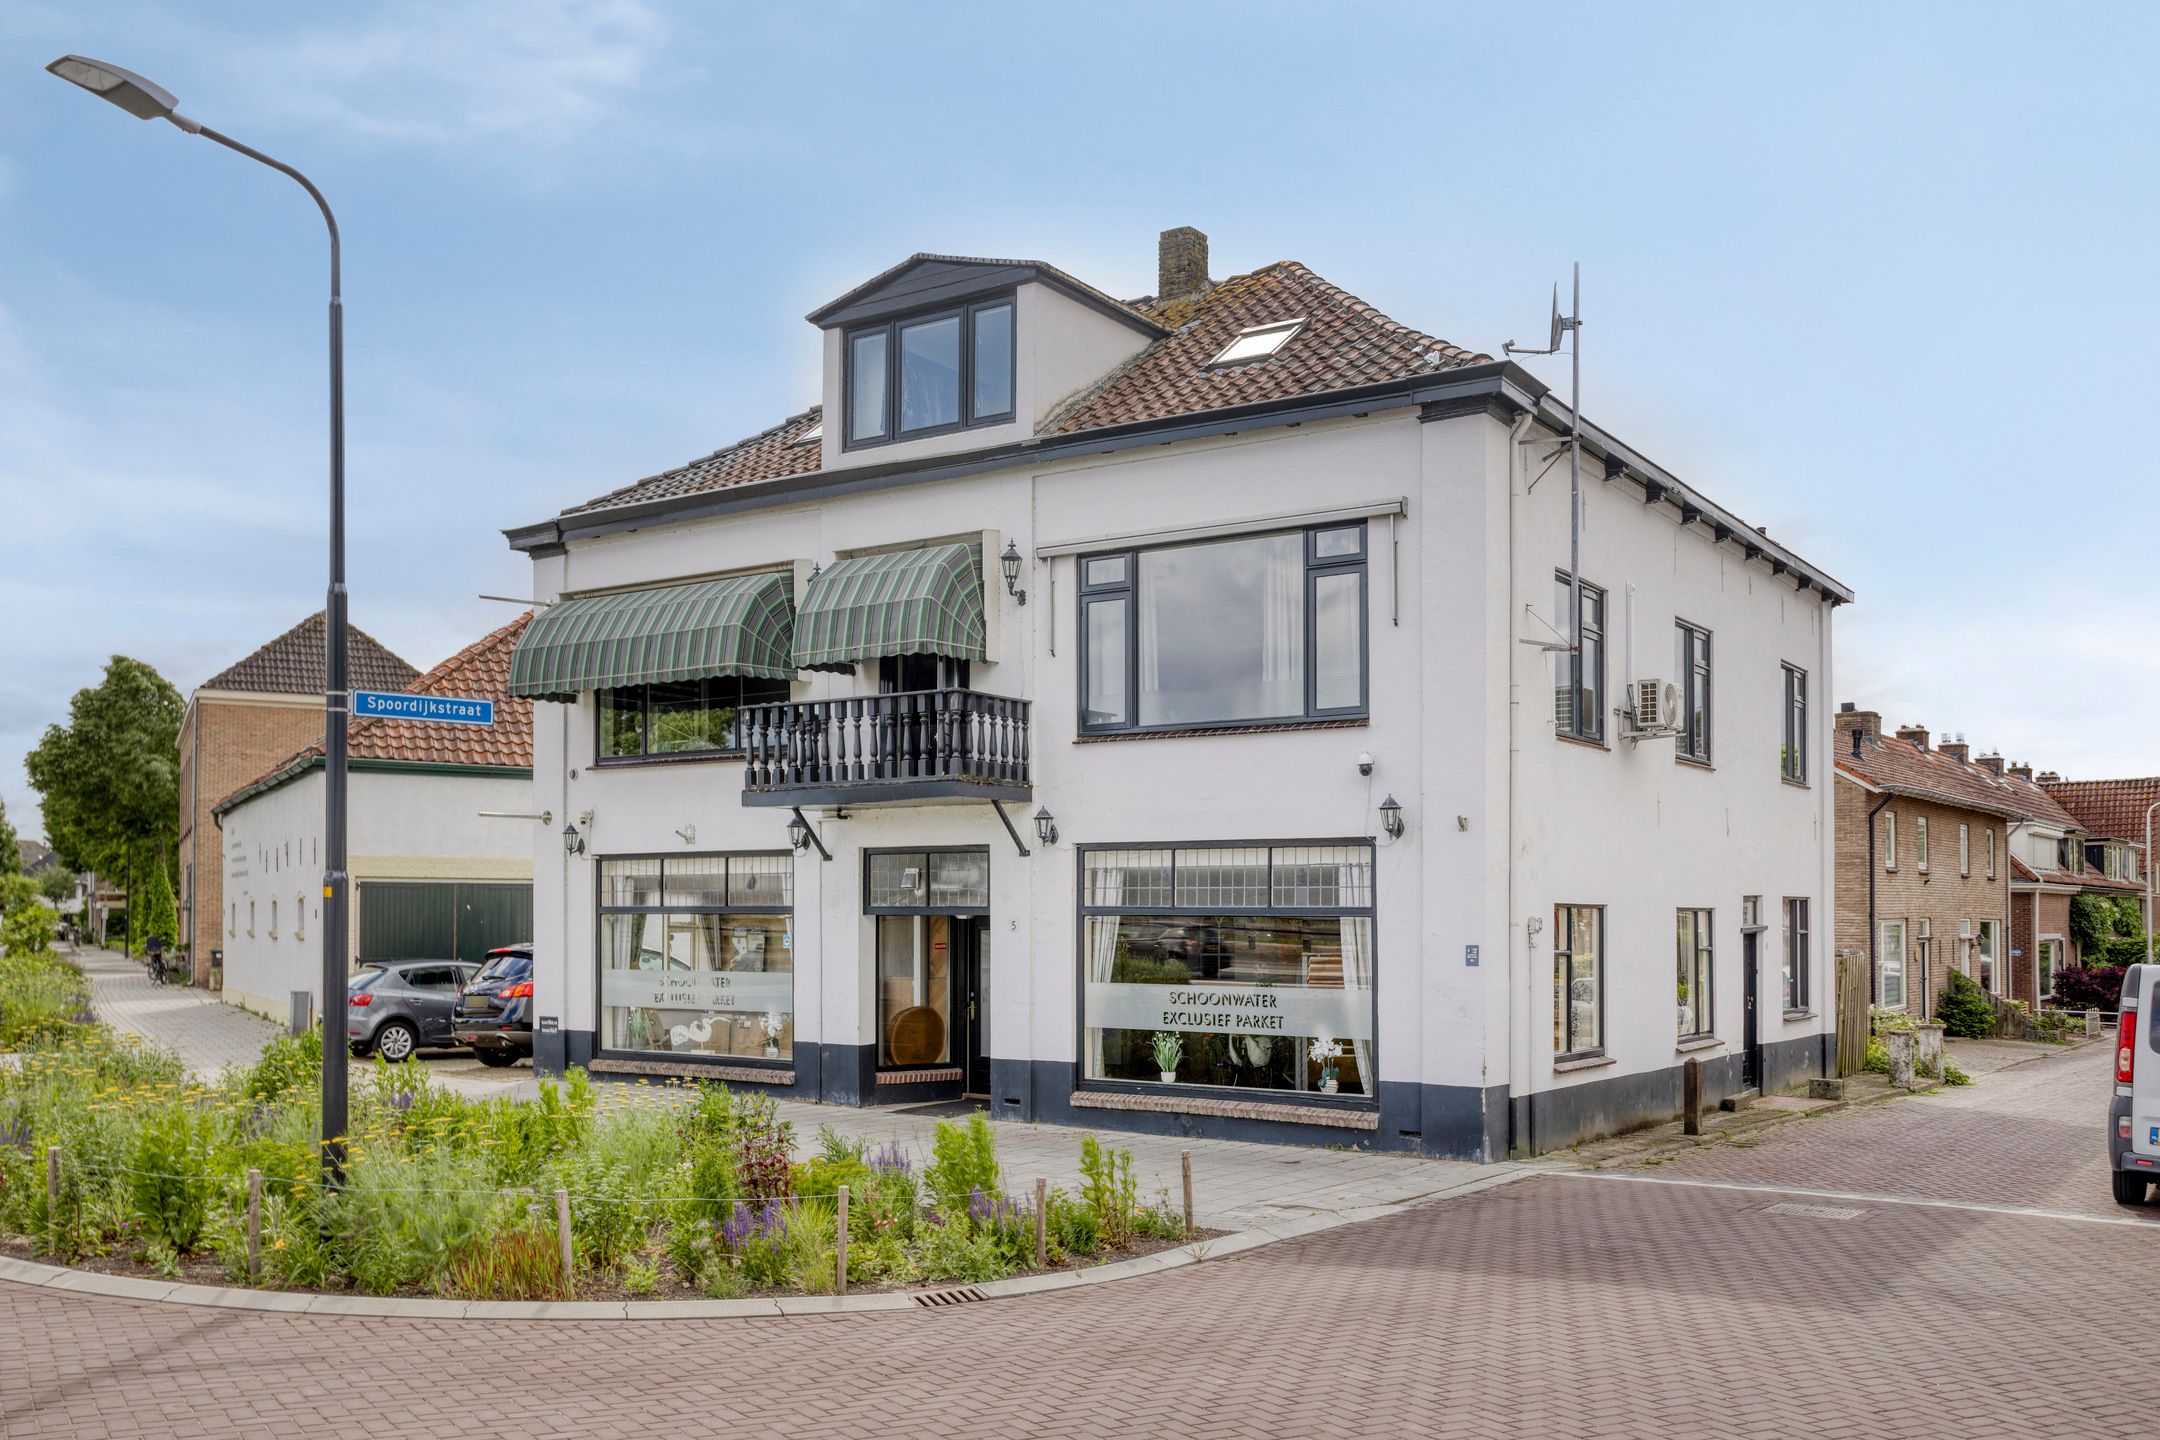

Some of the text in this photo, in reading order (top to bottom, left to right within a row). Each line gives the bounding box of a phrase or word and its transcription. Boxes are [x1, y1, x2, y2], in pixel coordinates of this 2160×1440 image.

[367, 696, 481, 717] Spoordijkstraat
[1011, 920, 1017, 931] 5
[1169, 991, 1278, 1008] SCHOONWATER
[1163, 1011, 1285, 1029] EXCLUSIEF PARKET
